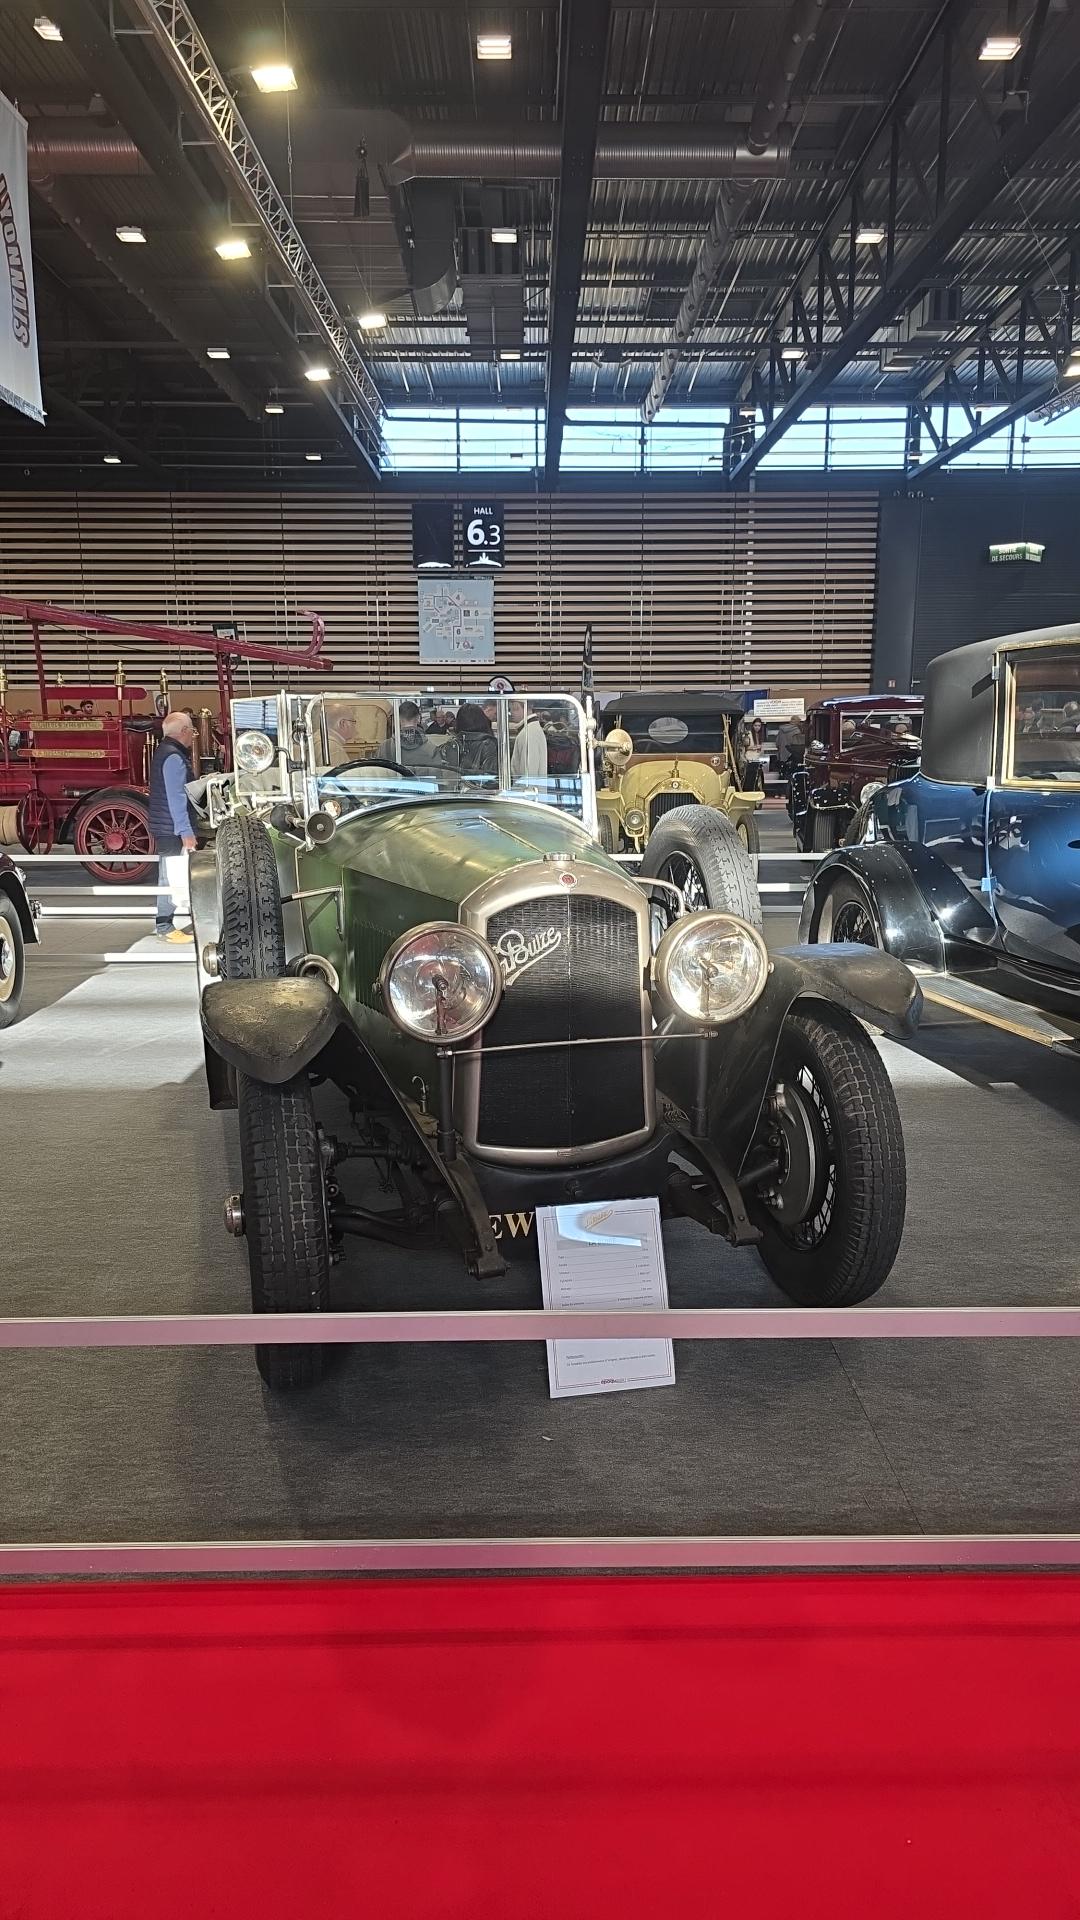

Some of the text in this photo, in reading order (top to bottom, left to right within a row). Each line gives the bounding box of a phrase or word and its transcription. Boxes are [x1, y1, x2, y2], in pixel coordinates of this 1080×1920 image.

[473, 507, 493, 515] HALL
[467, 519, 501, 546] 6.3
[999, 553, 1023, 562] SECOURS
